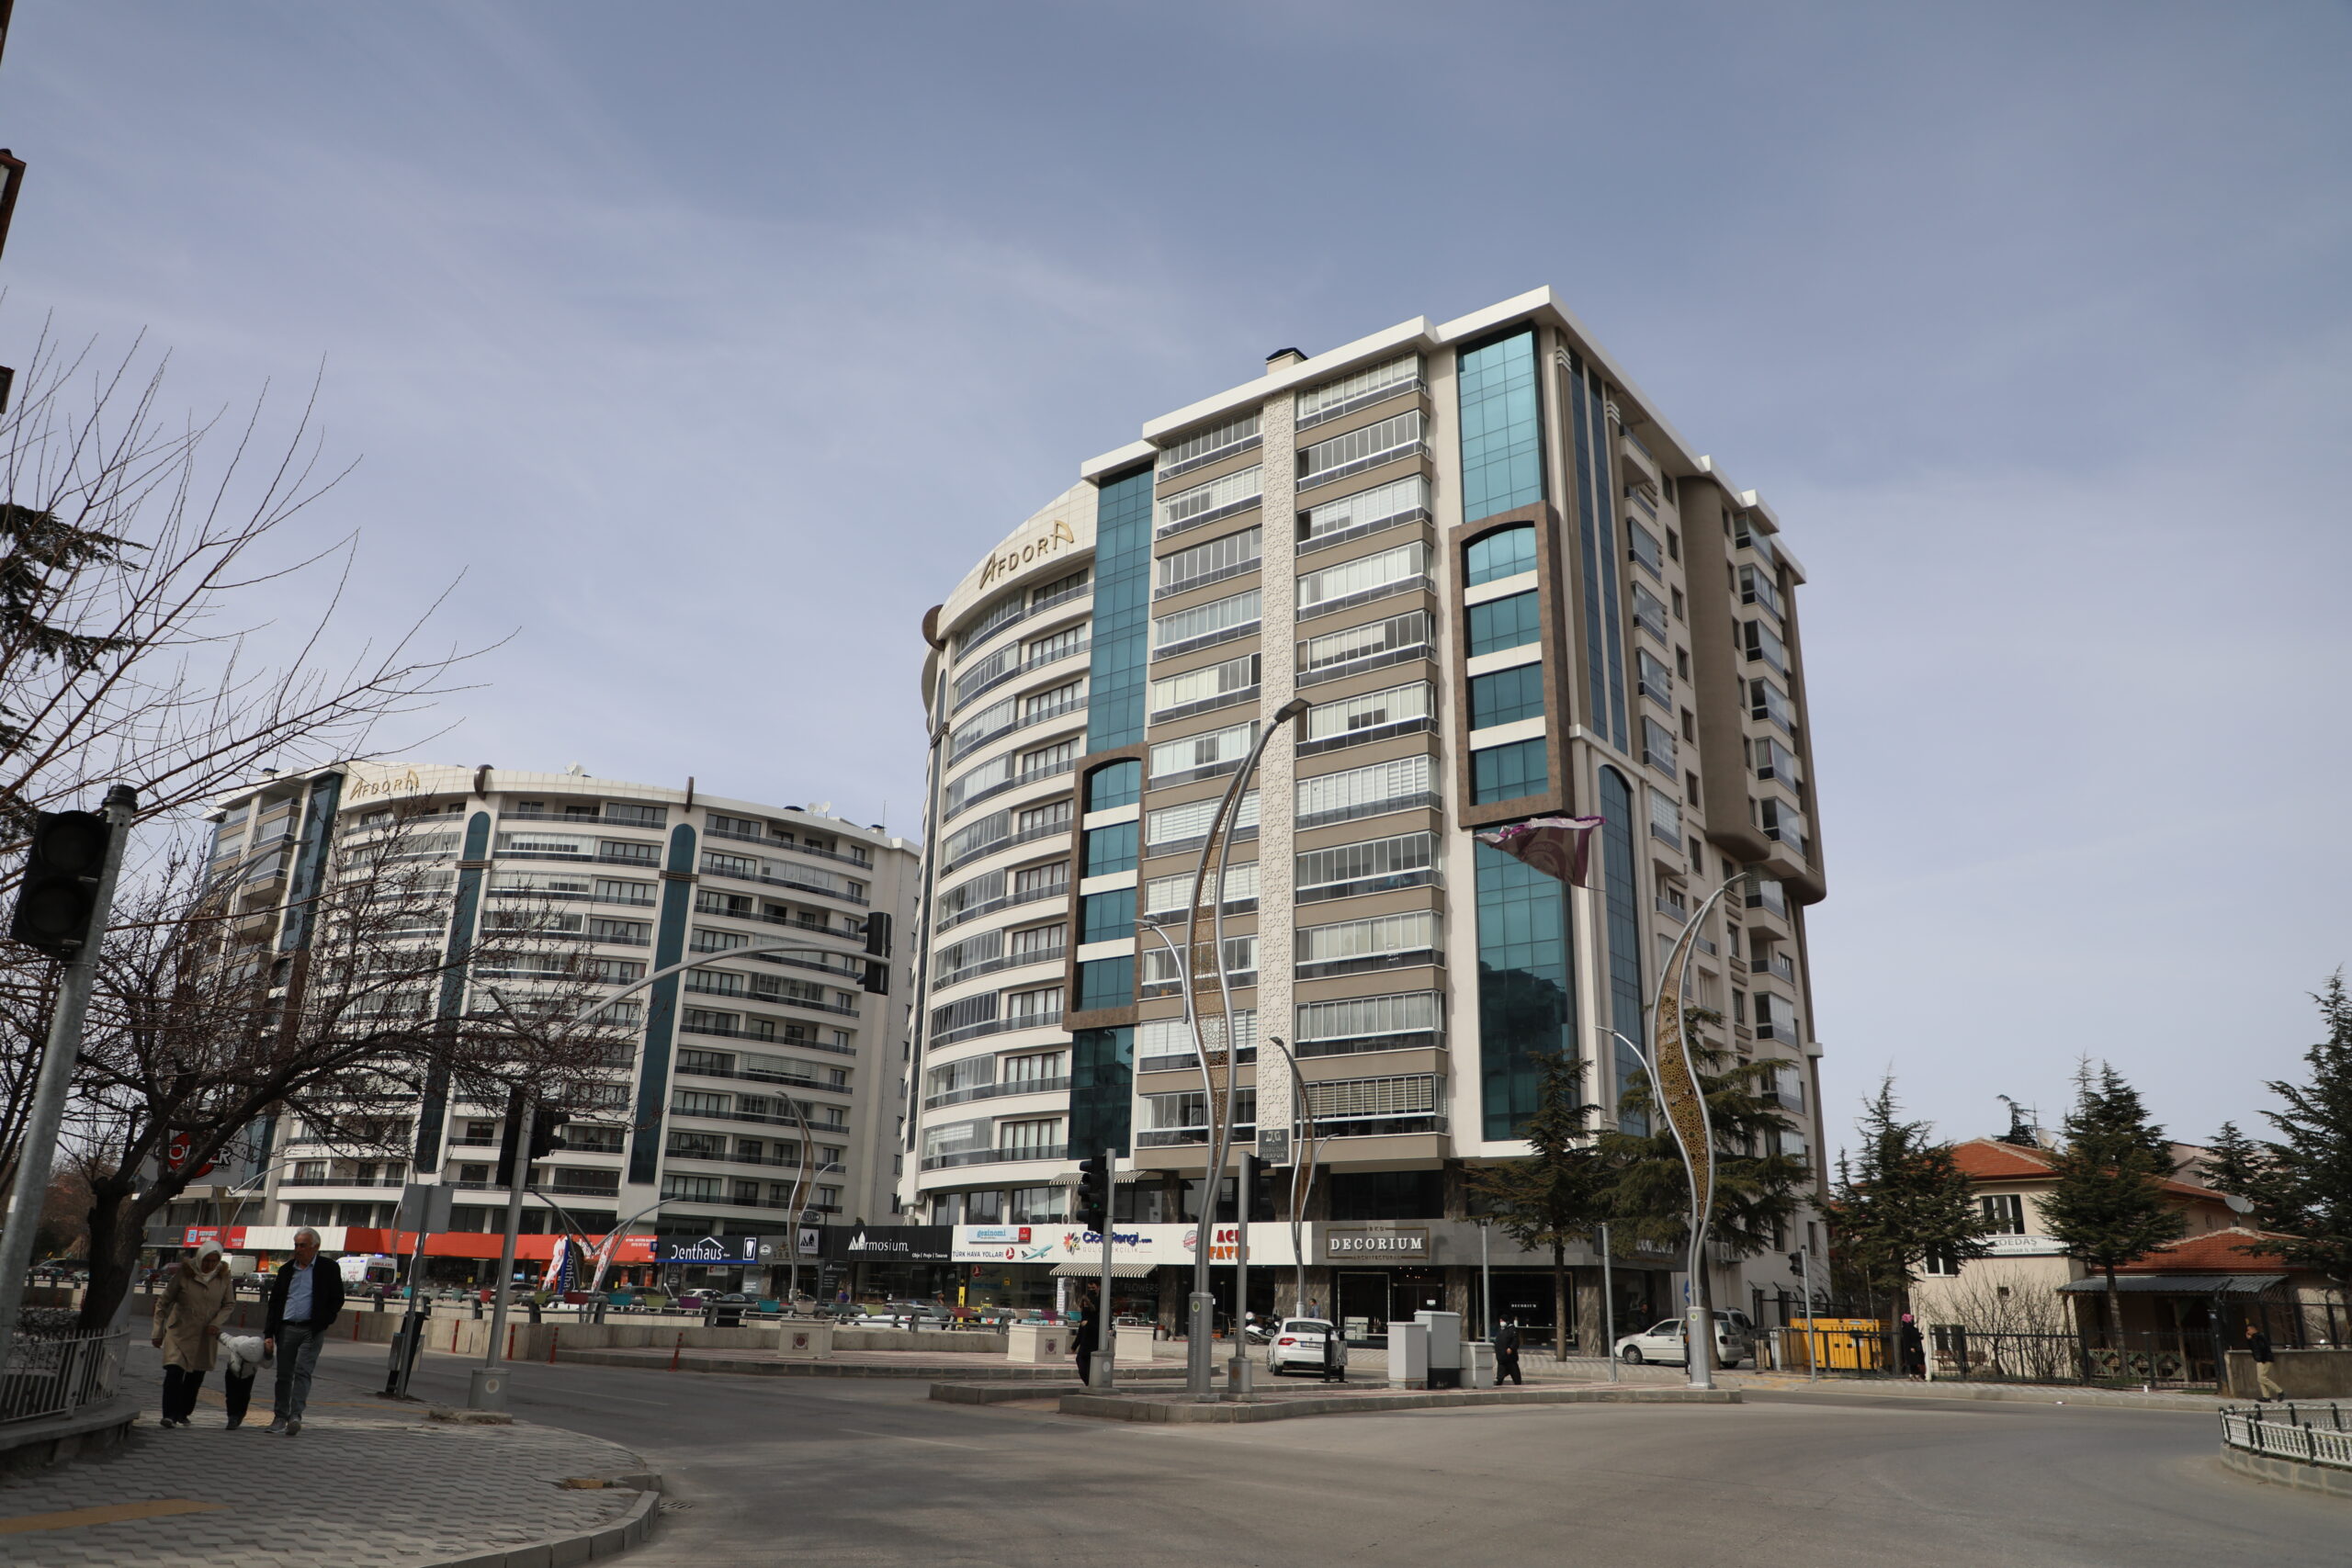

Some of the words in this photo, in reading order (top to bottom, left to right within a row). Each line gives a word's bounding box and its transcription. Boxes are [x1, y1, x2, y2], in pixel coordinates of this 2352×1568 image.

[978, 520, 1074, 590] AFDORA
[349, 769, 420, 800] AFDORA
[671, 1242, 723, 1261] Denthaus
[1329, 1237, 1423, 1251] DECORIUM
